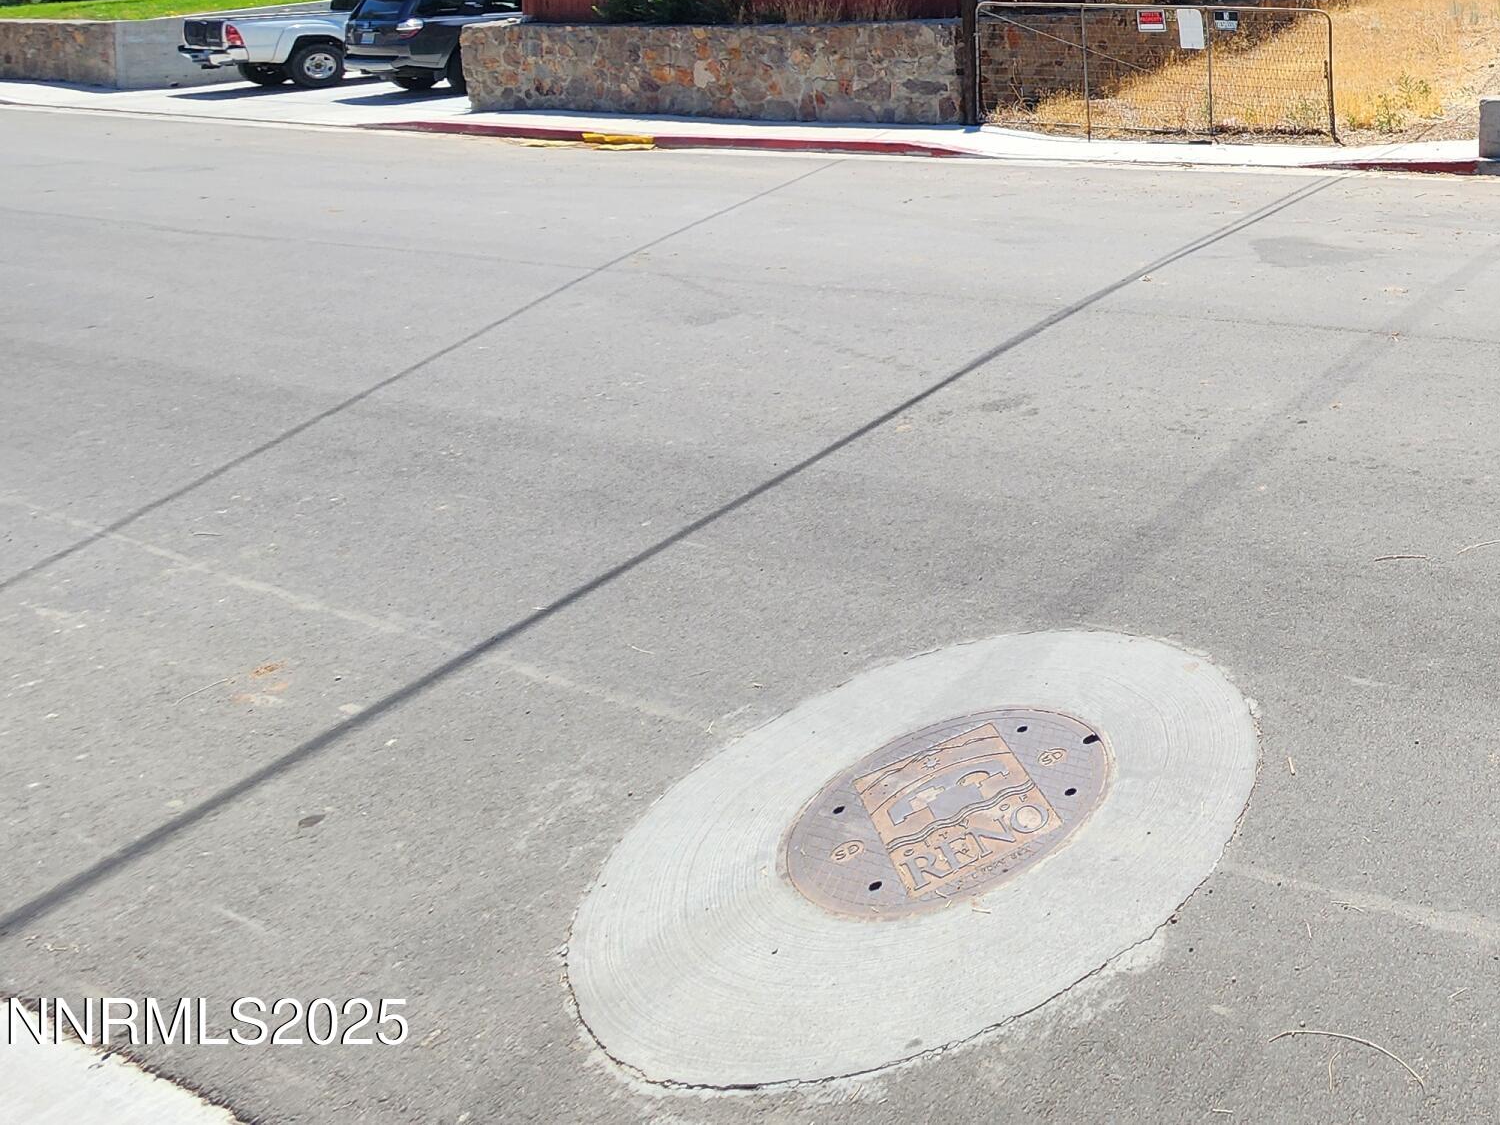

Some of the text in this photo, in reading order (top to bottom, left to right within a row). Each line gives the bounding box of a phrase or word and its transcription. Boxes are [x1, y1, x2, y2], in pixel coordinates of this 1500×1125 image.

[1041, 751, 1064, 766] SD
[904, 794, 1029, 857] CITY OF
[834, 844, 860, 861] SD
[900, 804, 1049, 891] RENO
